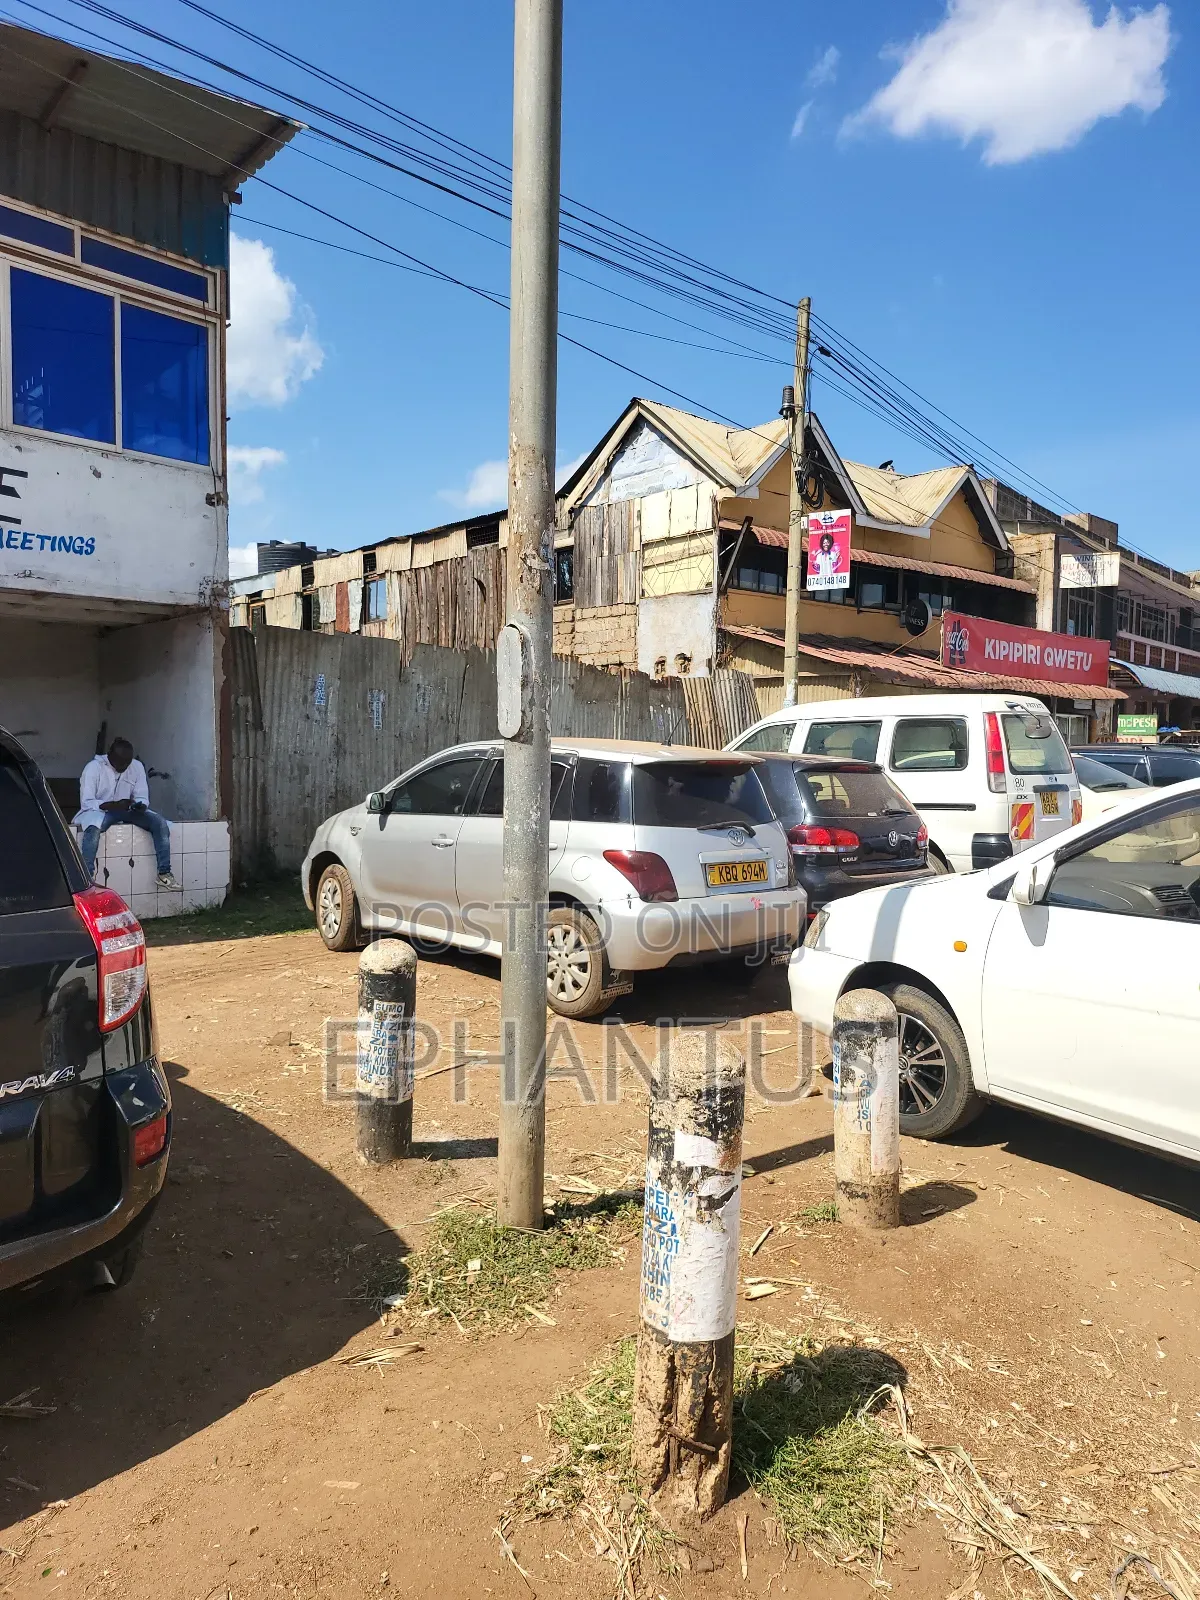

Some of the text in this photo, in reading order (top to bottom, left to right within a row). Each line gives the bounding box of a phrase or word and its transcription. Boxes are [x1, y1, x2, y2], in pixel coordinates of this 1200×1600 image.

[984, 637, 1093, 672] KIPIPIRI QWETU
[718, 865, 738, 882] KBQ
[742, 863, 766, 881] 694M
[0, 1066, 76, 1098] RAV4
